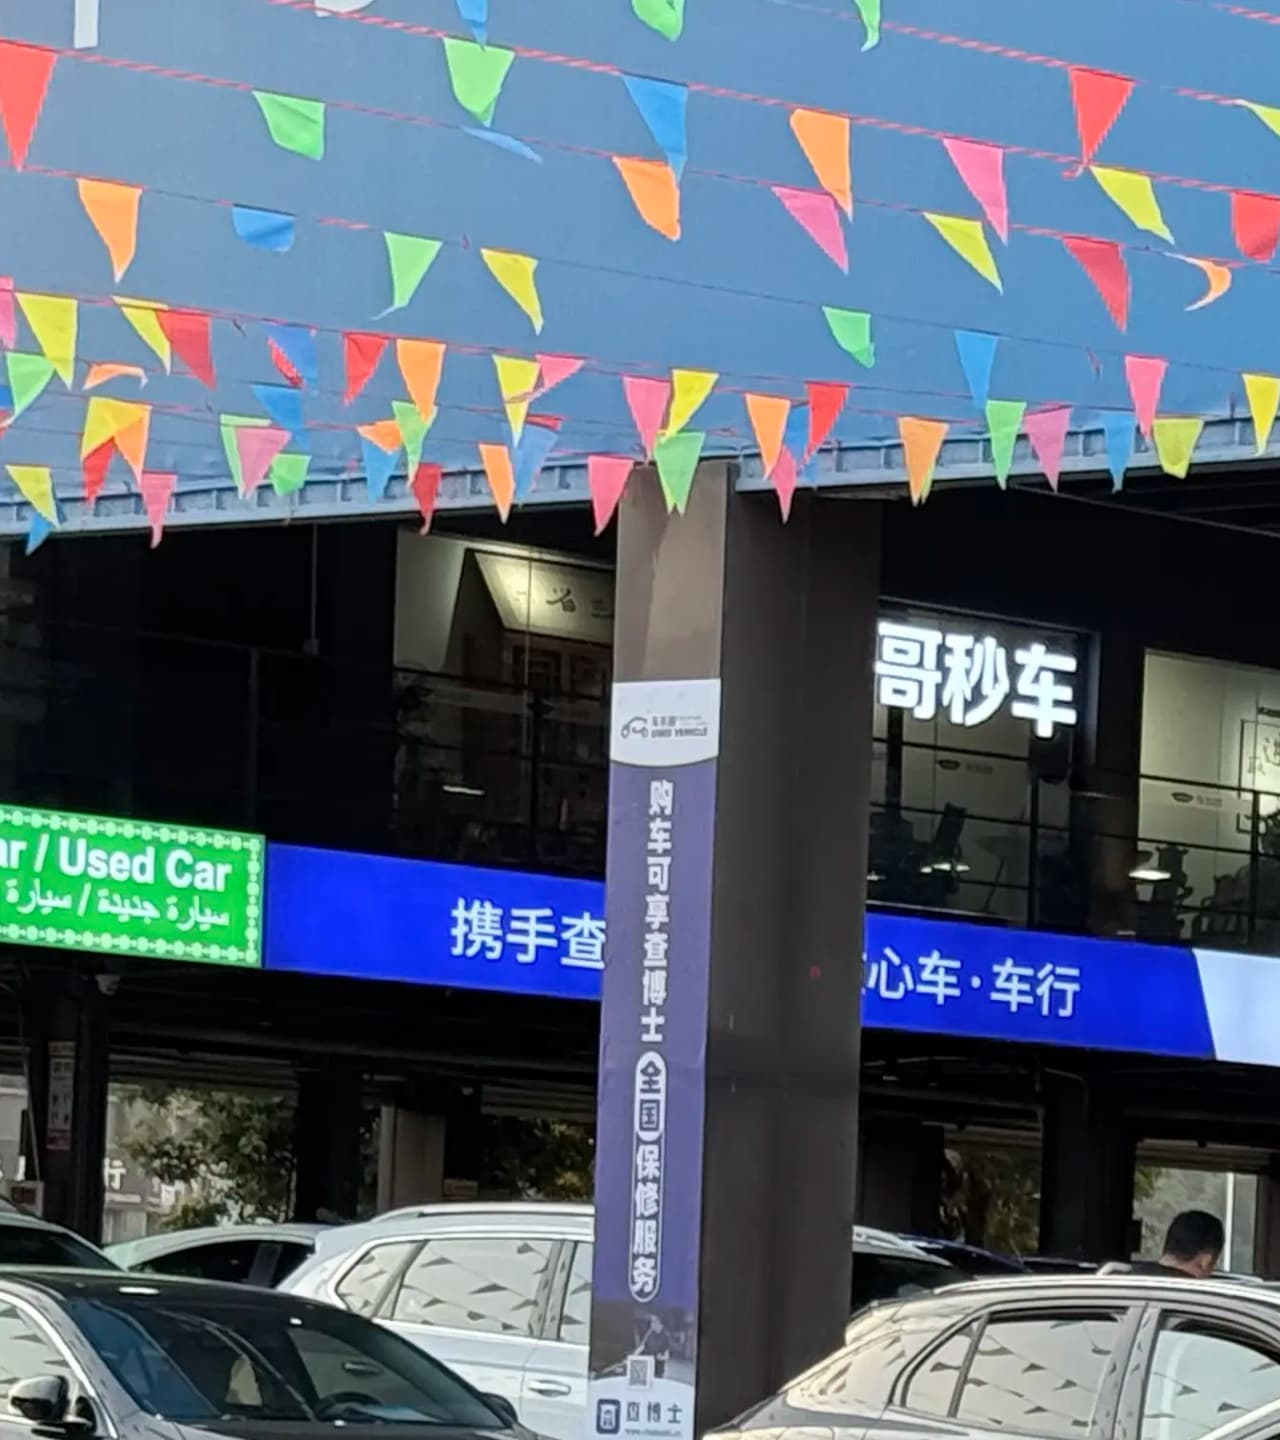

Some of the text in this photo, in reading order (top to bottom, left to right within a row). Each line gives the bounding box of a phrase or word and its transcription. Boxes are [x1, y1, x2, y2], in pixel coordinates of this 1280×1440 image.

[875, 623, 1078, 739] 哥秒车
[58, 836, 155, 885] Used
[165, 850, 232, 892] Car
[450, 897, 606, 970] 携手查
[641, 779, 674, 1043] 购车可享查博士
[861, 946, 1081, 1017] 心车·车行
